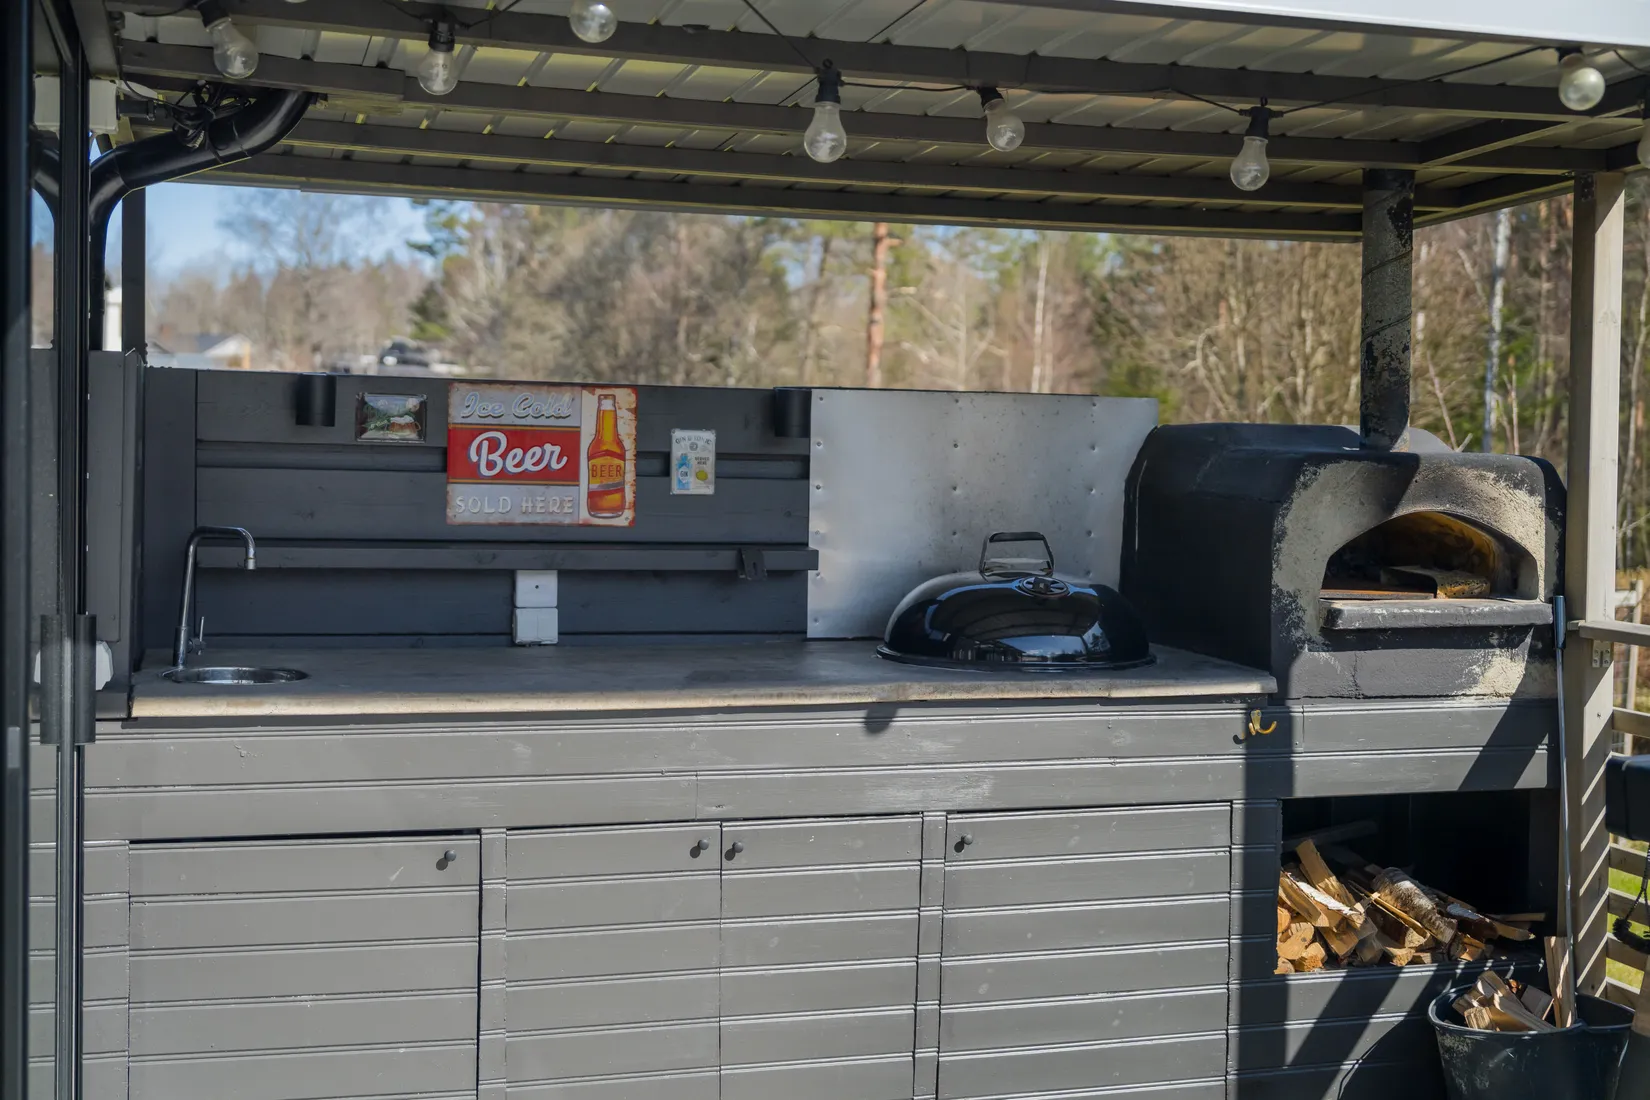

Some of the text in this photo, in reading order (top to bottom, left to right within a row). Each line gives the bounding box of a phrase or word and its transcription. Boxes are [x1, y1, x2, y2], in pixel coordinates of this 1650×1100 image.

[461, 391, 573, 419] Ice Cold
[468, 430, 568, 477] Beer
[591, 463, 623, 479] BEER
[454, 495, 574, 516] SOLD HERE
